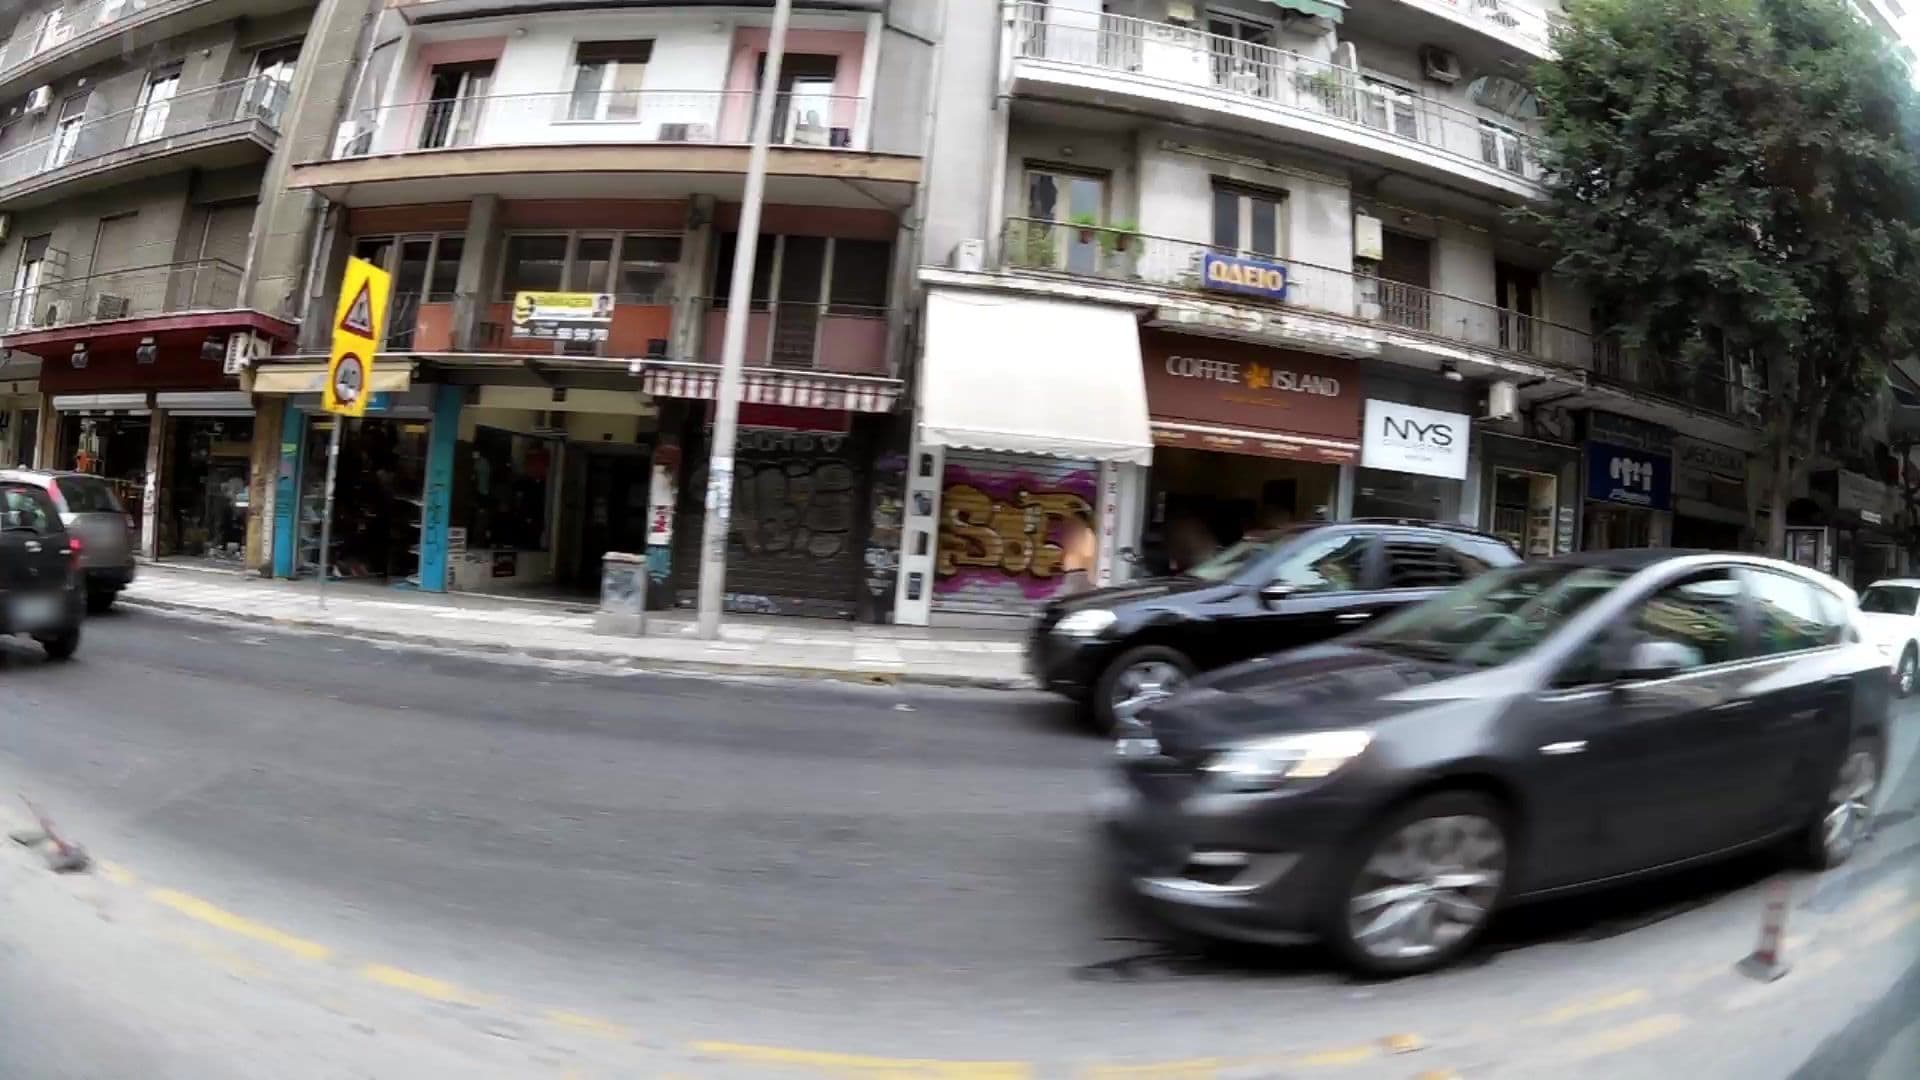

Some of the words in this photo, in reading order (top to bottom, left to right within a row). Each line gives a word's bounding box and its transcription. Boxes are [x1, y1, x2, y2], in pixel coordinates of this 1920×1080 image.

[1165, 355, 1240, 383] COFFEE
[1272, 369, 1340, 397] ISLAND
[1384, 416, 1453, 446] NYS
